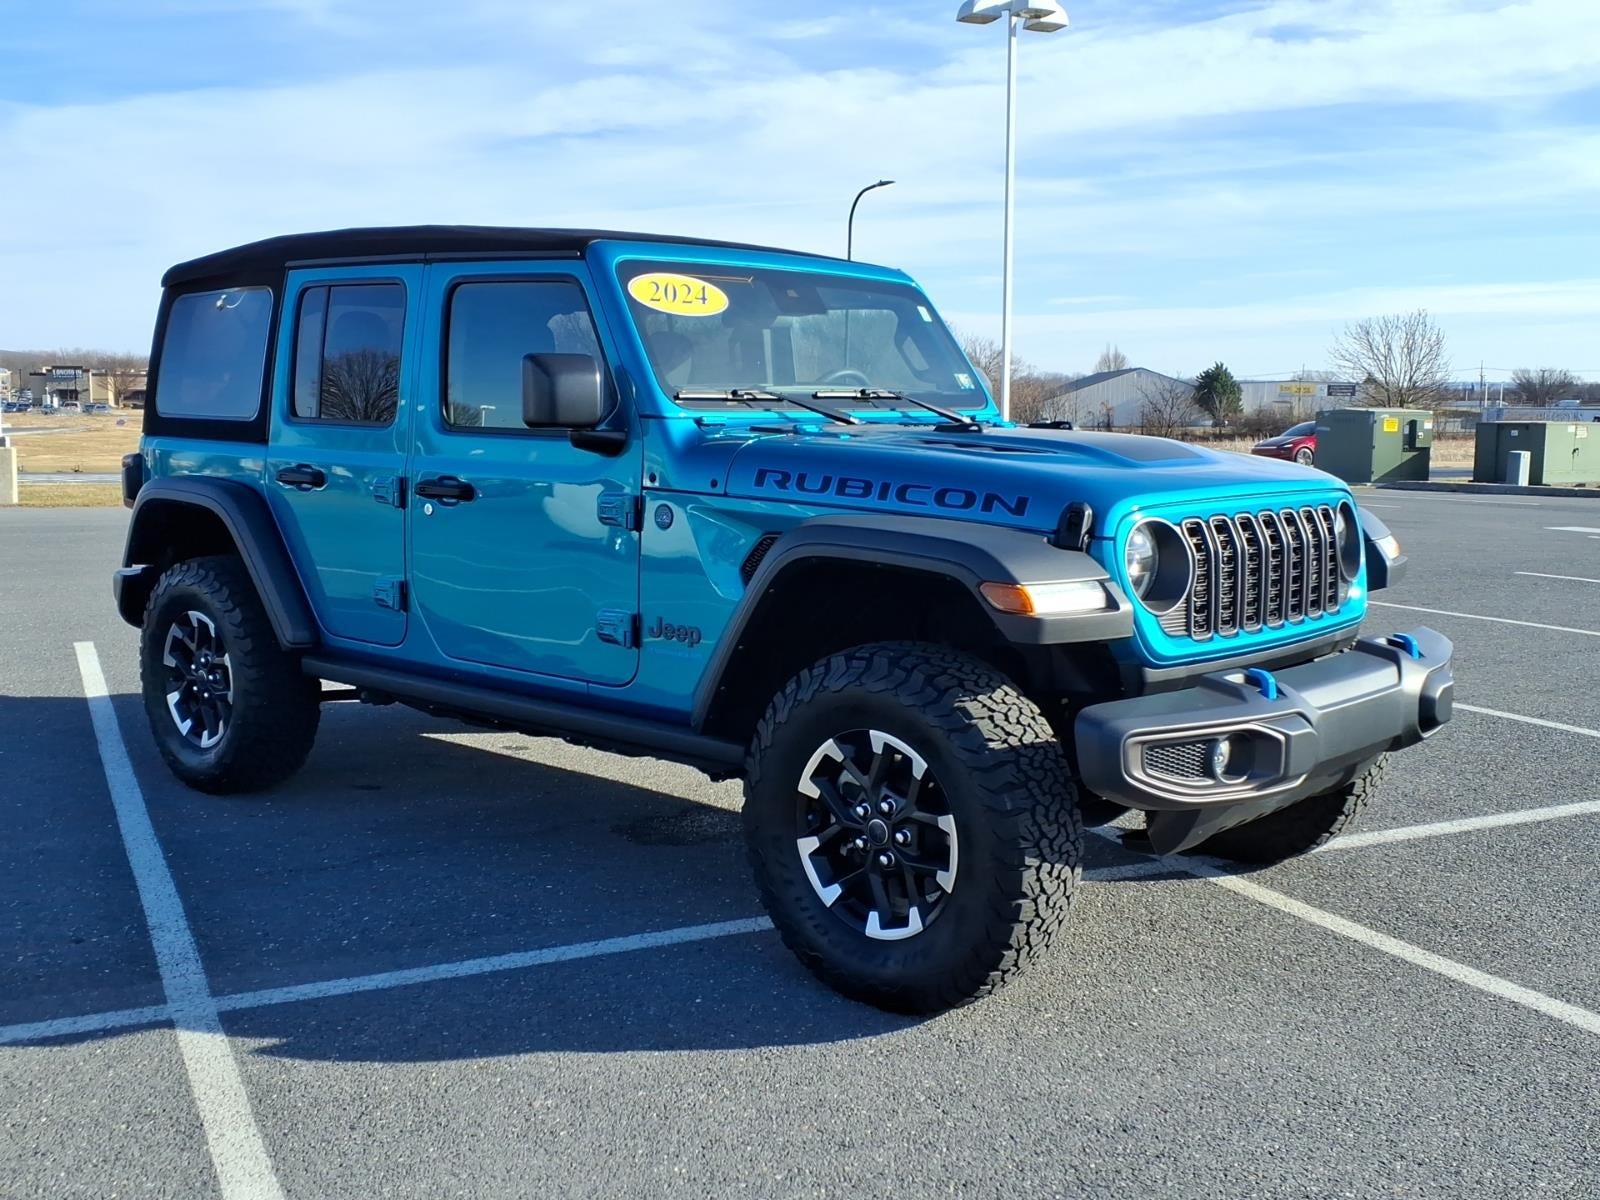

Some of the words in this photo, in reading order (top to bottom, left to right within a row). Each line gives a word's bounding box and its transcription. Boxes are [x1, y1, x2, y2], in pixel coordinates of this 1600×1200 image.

[648, 281, 708, 304] 2024
[752, 467, 1032, 518] RUBICON
[648, 616, 702, 648] Jeep
